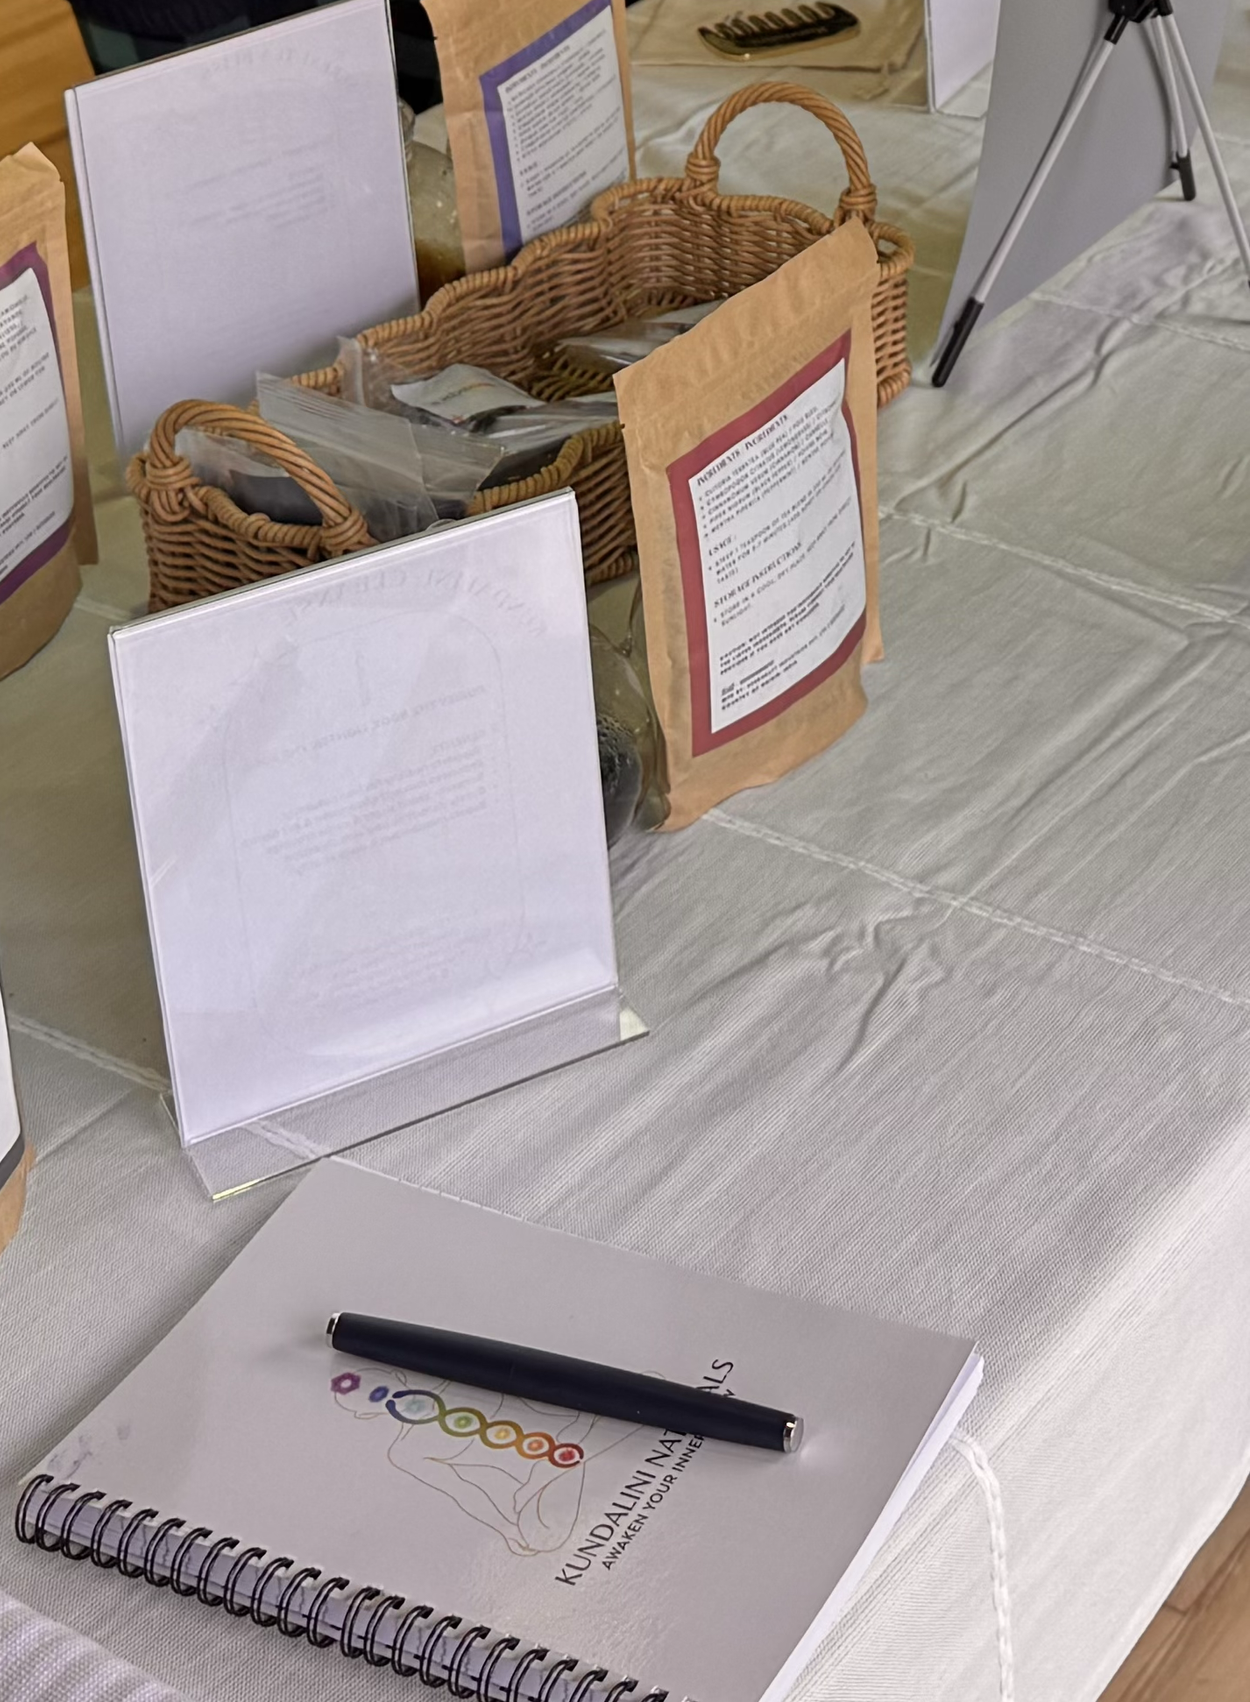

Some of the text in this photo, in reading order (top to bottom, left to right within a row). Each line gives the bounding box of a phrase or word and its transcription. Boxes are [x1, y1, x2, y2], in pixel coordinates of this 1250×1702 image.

[554, 1469, 657, 1587] KUNDALINI
[601, 1513, 649, 1571] AWAKEN
[642, 1473, 679, 1512] YOUR
